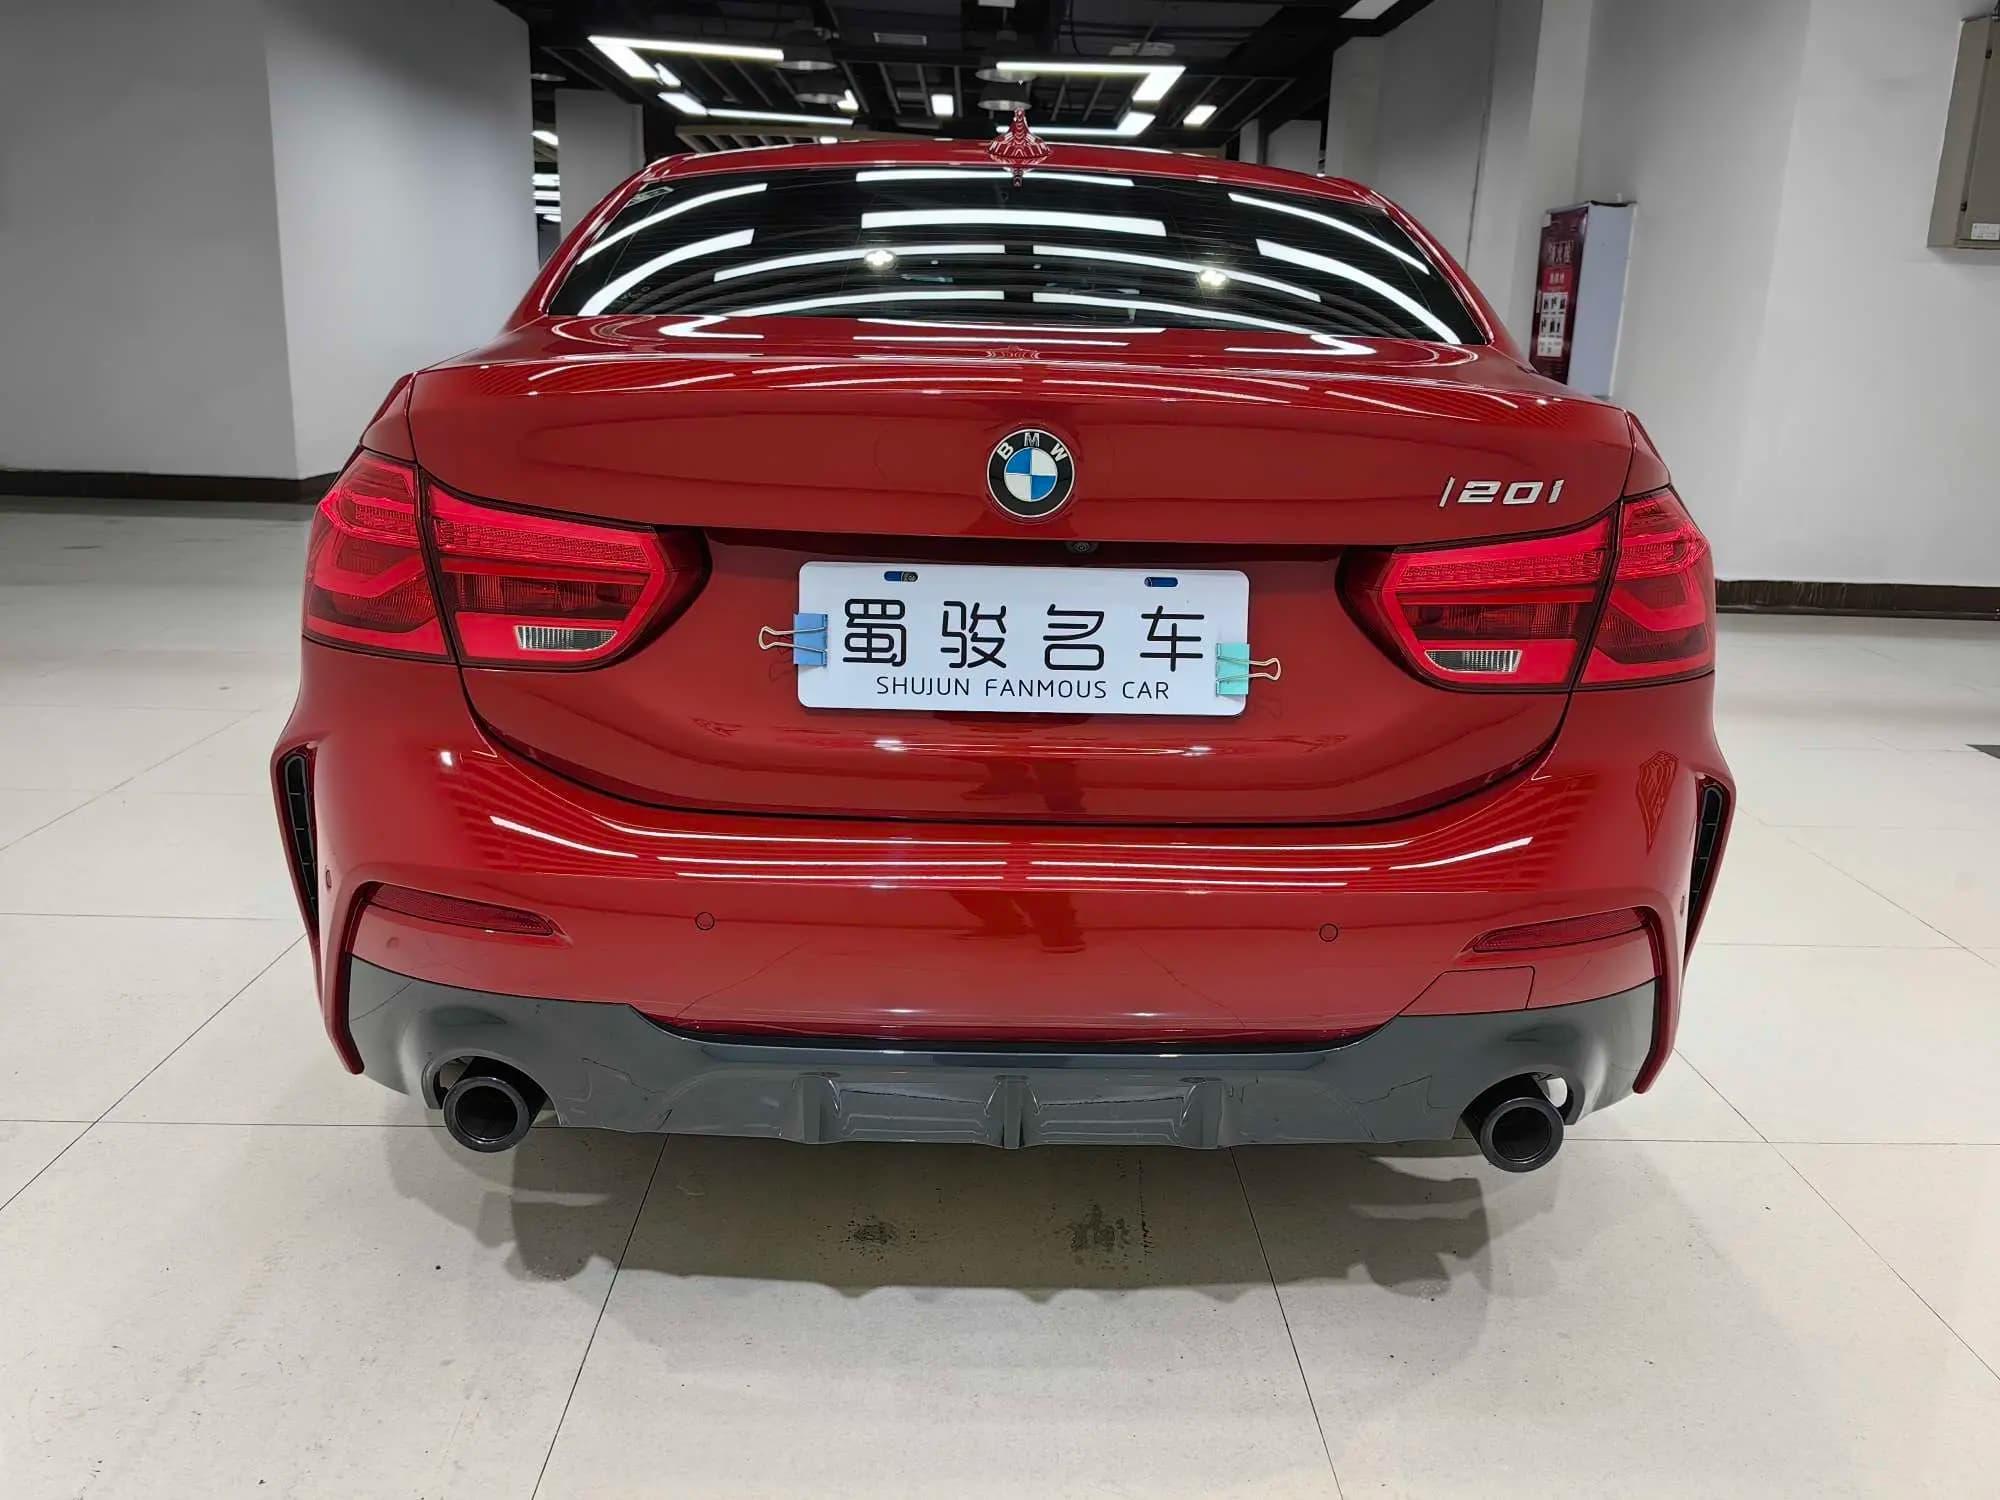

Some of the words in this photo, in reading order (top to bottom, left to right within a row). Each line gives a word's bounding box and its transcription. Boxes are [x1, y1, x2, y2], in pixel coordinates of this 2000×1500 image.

[997, 432, 1068, 462] BMW
[1439, 476, 1565, 508] 120i
[842, 598, 1205, 672] 蜀骏名车
[876, 676, 970, 696] SHUJUN
[985, 678, 1107, 699] FANMOUS
[1122, 681, 1169, 700] CAR
